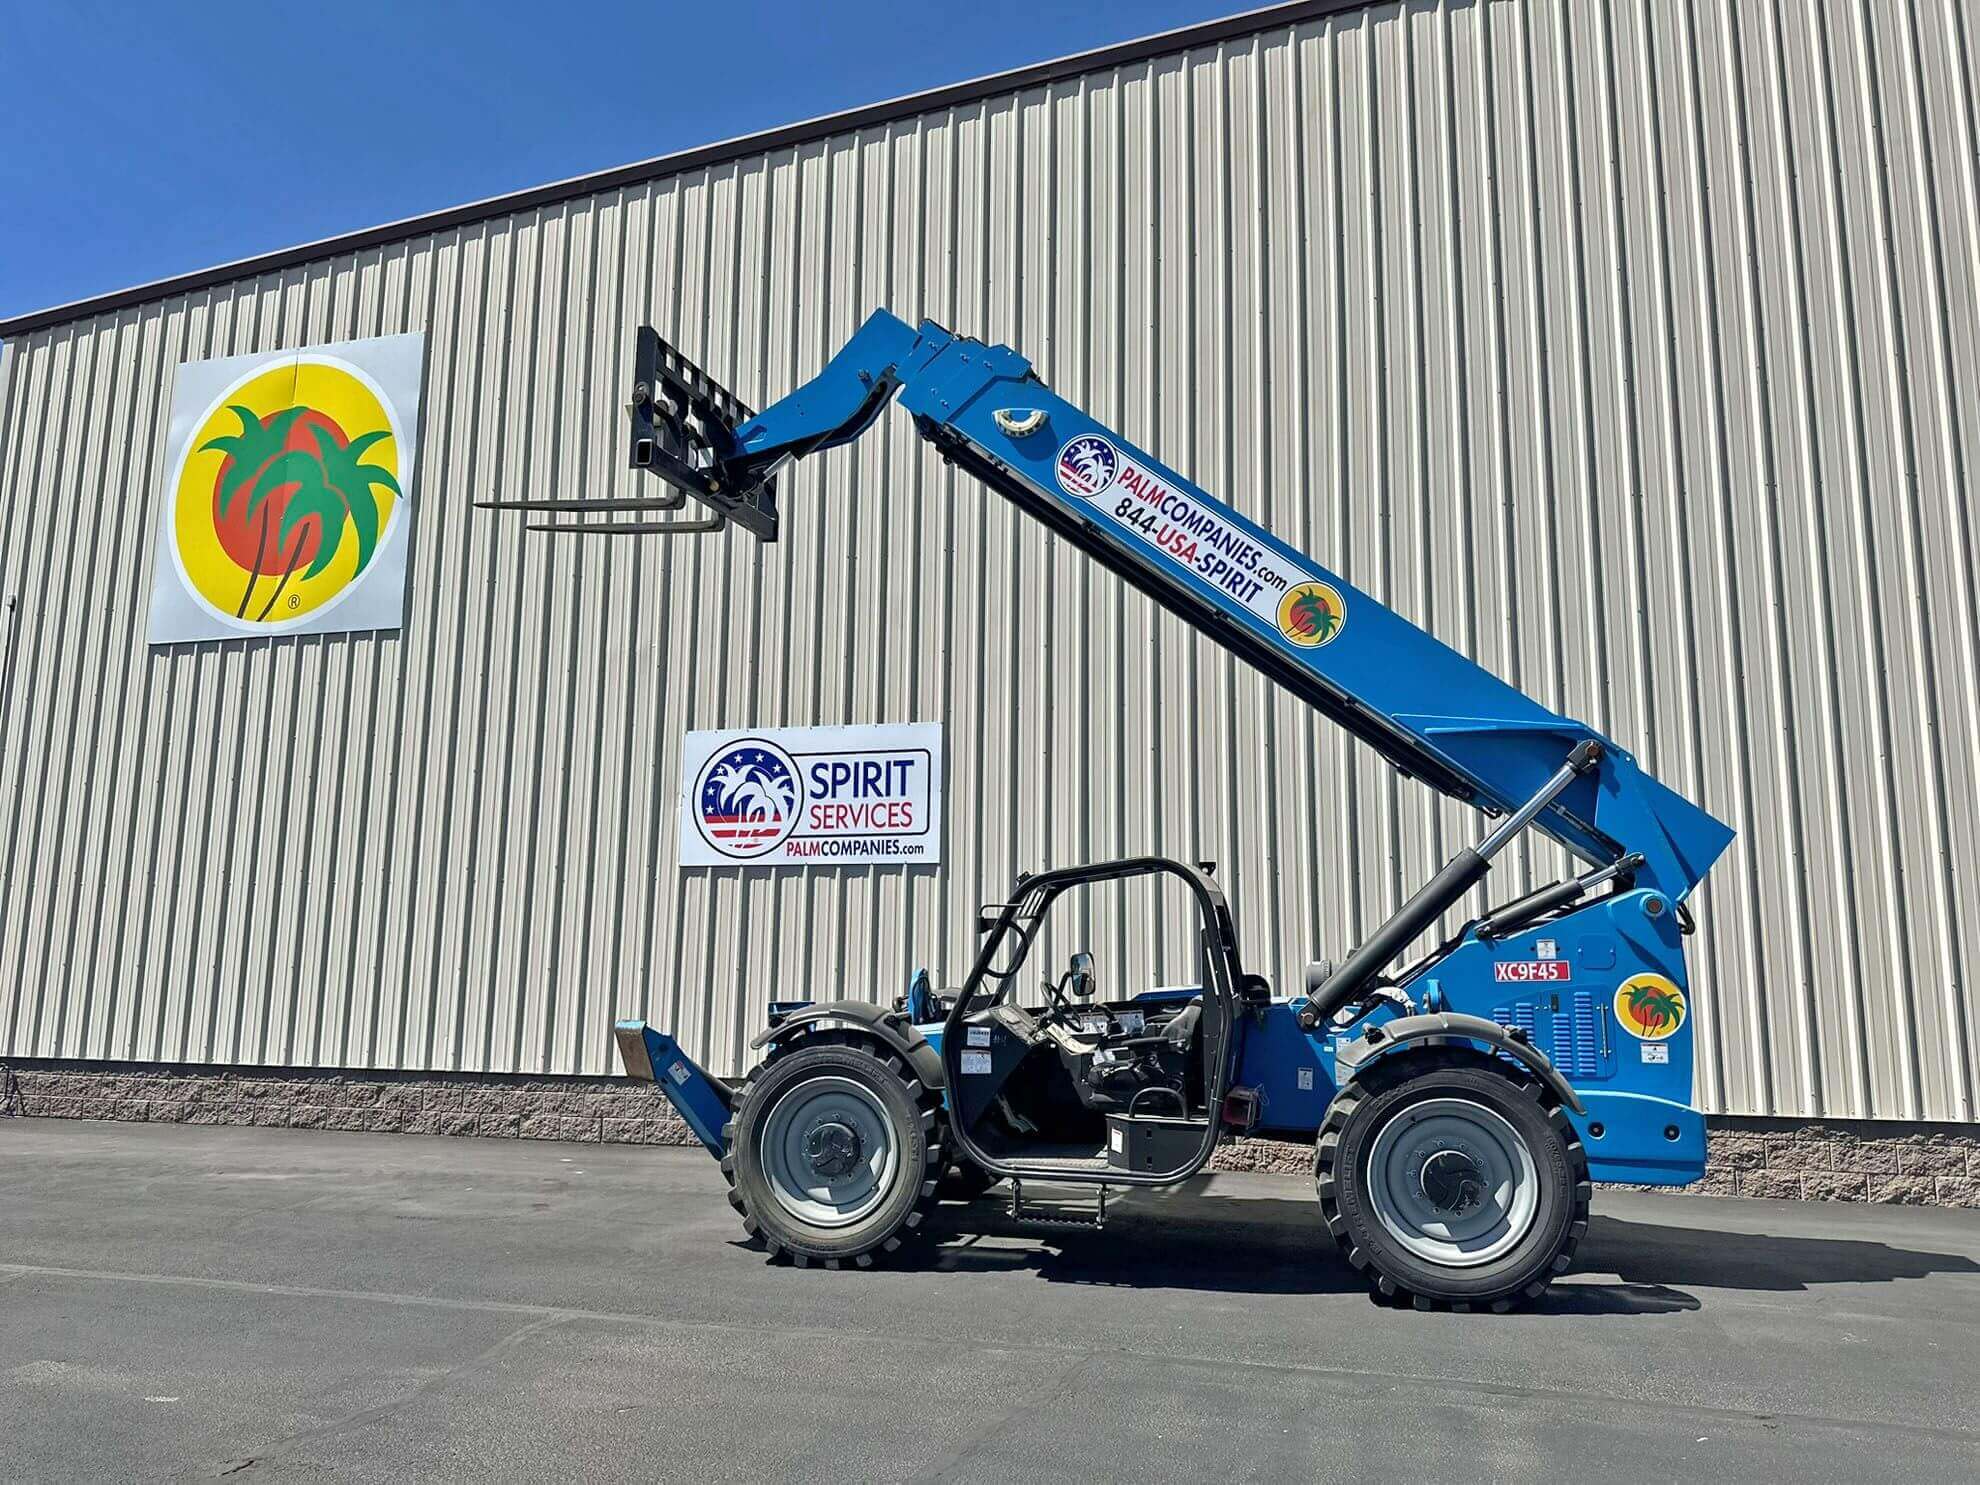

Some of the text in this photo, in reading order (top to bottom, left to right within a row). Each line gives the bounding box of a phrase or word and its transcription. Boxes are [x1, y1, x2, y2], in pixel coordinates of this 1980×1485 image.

[1117, 465, 1289, 592] PALMCOMPANIES.com
[1114, 498, 1264, 604] 844-USA-SPIRIT
[809, 759, 915, 799] SPIRIT
[809, 802, 913, 830] SERVICES
[786, 839, 925, 857] PALMCOMPANIES.com
[1497, 963, 1559, 981] XC9F45
